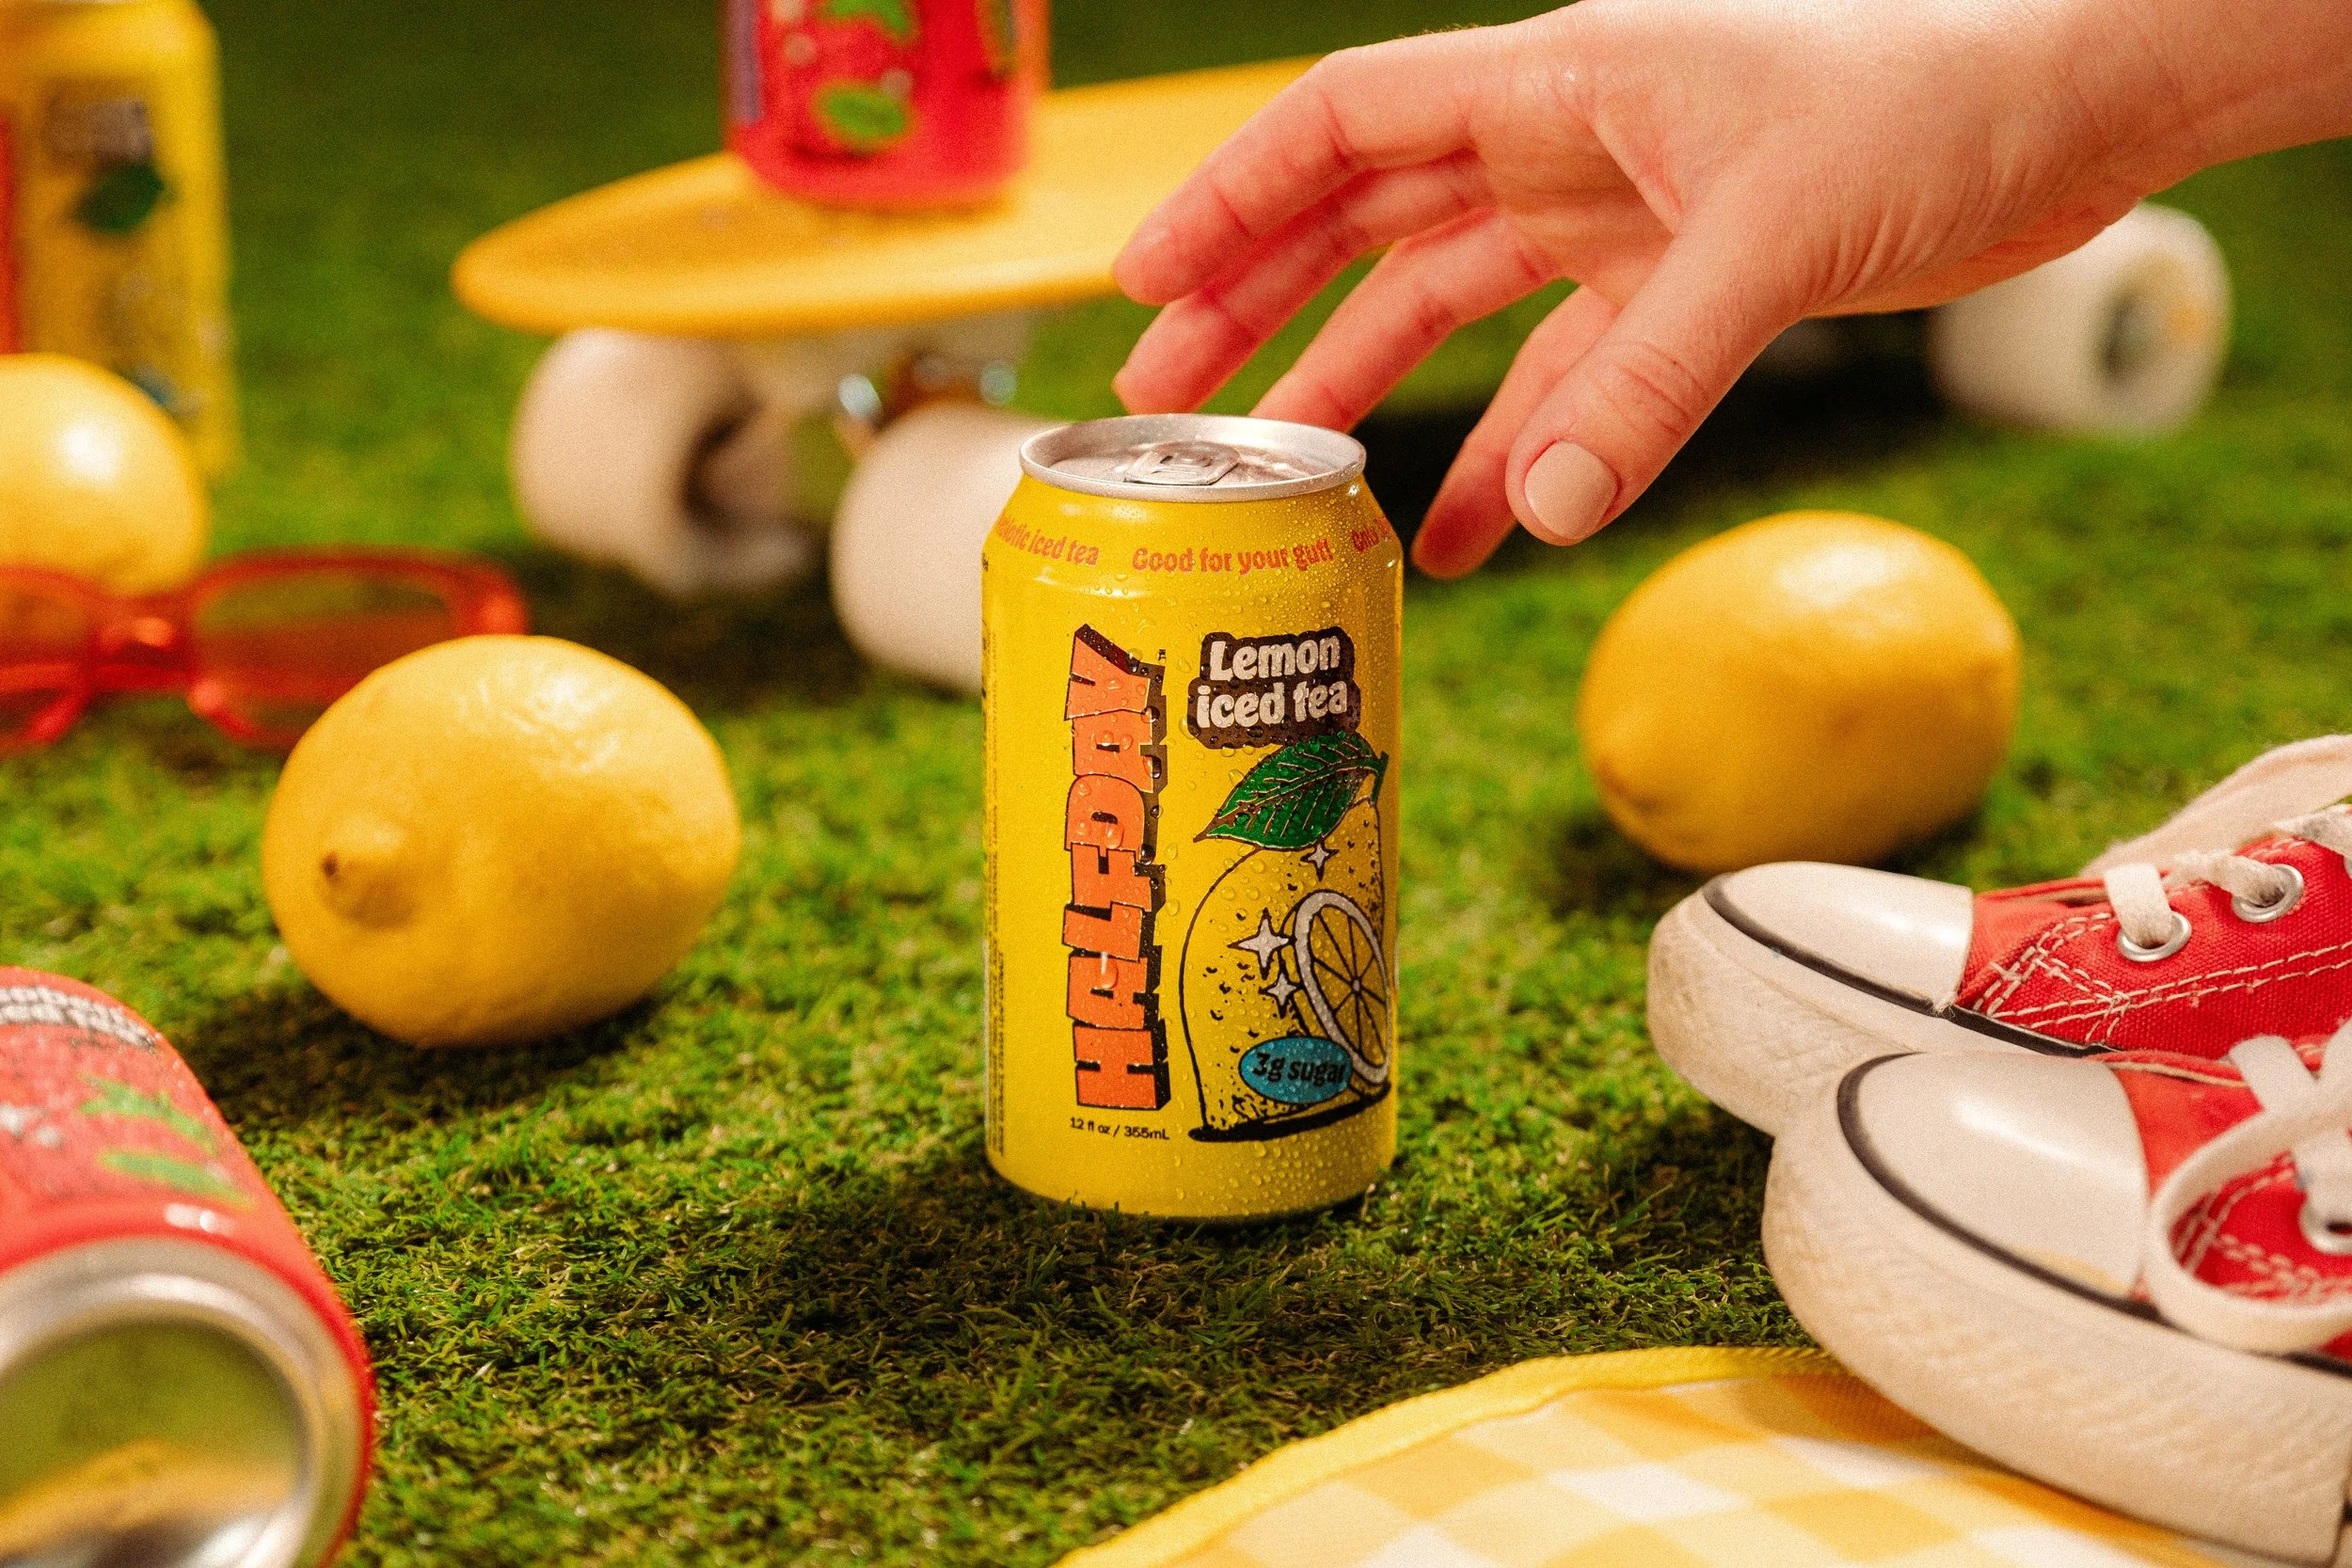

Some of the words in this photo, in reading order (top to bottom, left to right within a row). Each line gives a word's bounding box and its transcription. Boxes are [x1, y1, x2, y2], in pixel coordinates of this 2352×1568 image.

[1027, 529, 1068, 560] iced
[1065, 539, 1100, 566] tea
[1132, 546, 1194, 572] Good
[1199, 546, 1232, 573] for
[1237, 547, 1289, 576] your
[1209, 635, 1342, 682] Lemon
[1196, 681, 1286, 729] iced
[1293, 680, 1348, 723] tea
[1061, 624, 1171, 1110] HALFDAY
[1252, 1051, 1286, 1083] 3g
[1287, 1060, 1347, 1087] sugar
[1070, 1117, 1085, 1131] 12
[1087, 1119, 1095, 1132] fl
[1097, 1124, 1111, 1135] oz
[1112, 1124, 1121, 1138] /
[1123, 1125, 1170, 1140] 355mL
